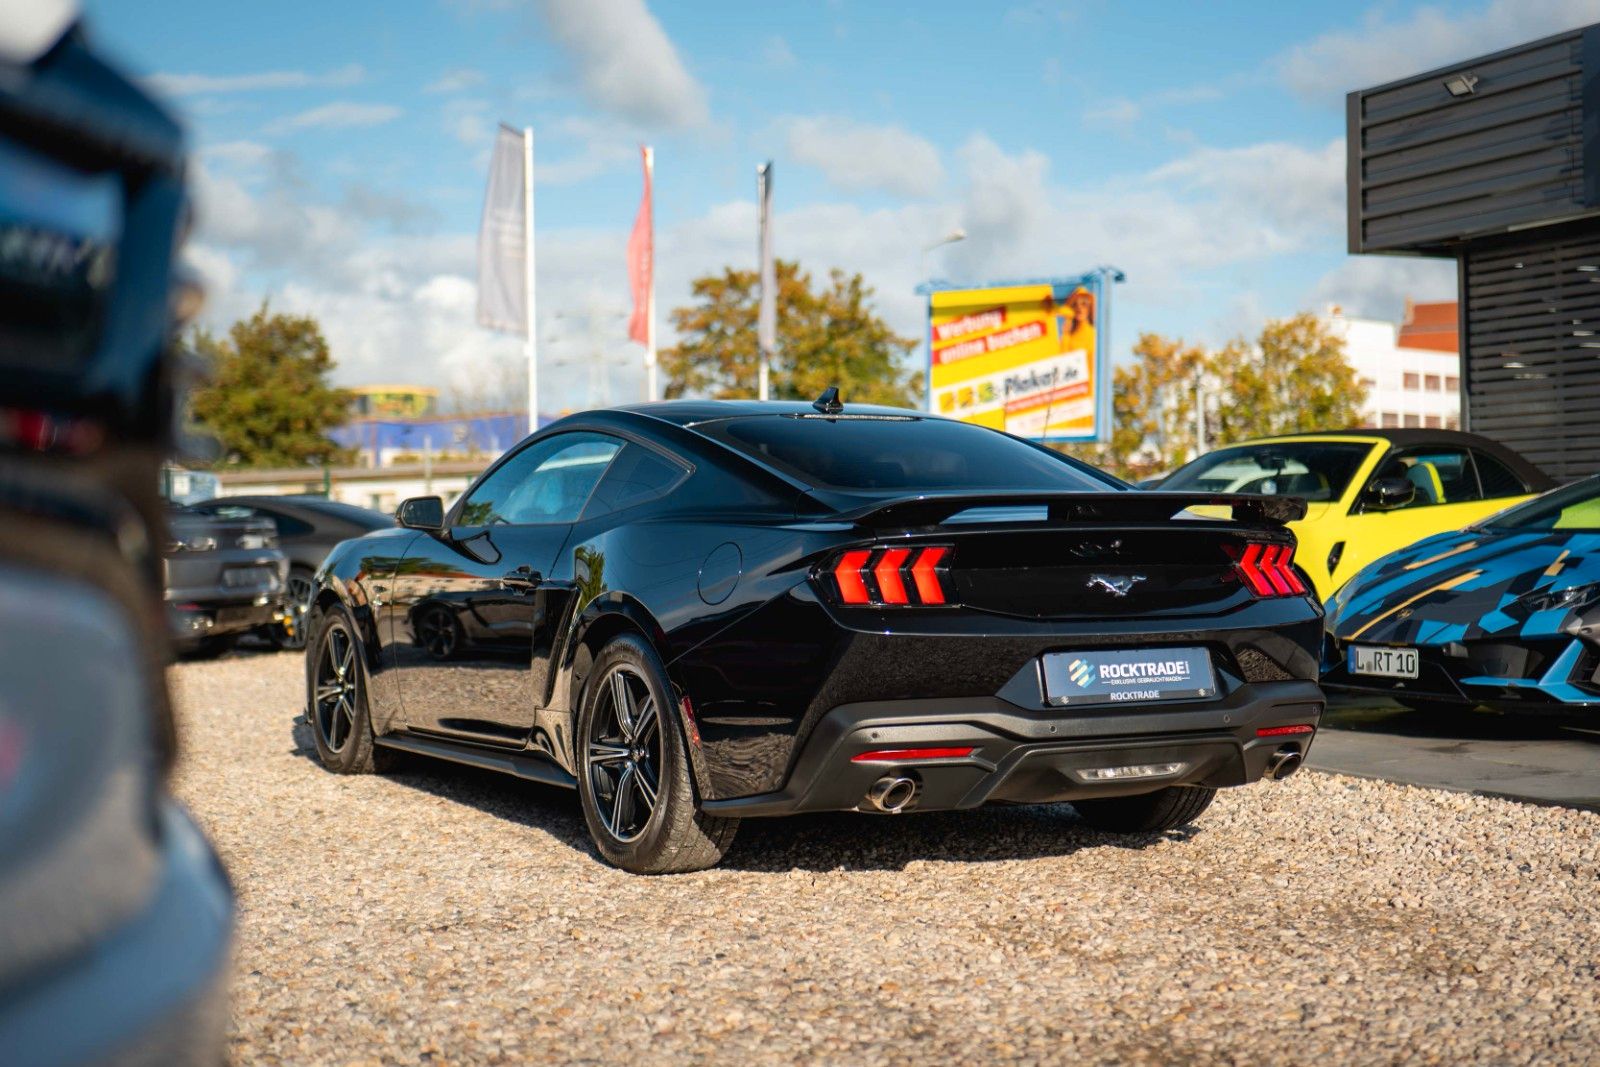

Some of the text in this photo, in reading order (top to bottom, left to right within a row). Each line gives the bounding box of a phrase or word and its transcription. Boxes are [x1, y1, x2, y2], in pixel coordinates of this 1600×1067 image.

[1099, 661, 1186, 678] ROCKTRADE
[1111, 676, 1182, 686] EXKLUSIVE GEBRAUCHTWAGEN
[1110, 690, 1160, 700] ROCKTRADE
